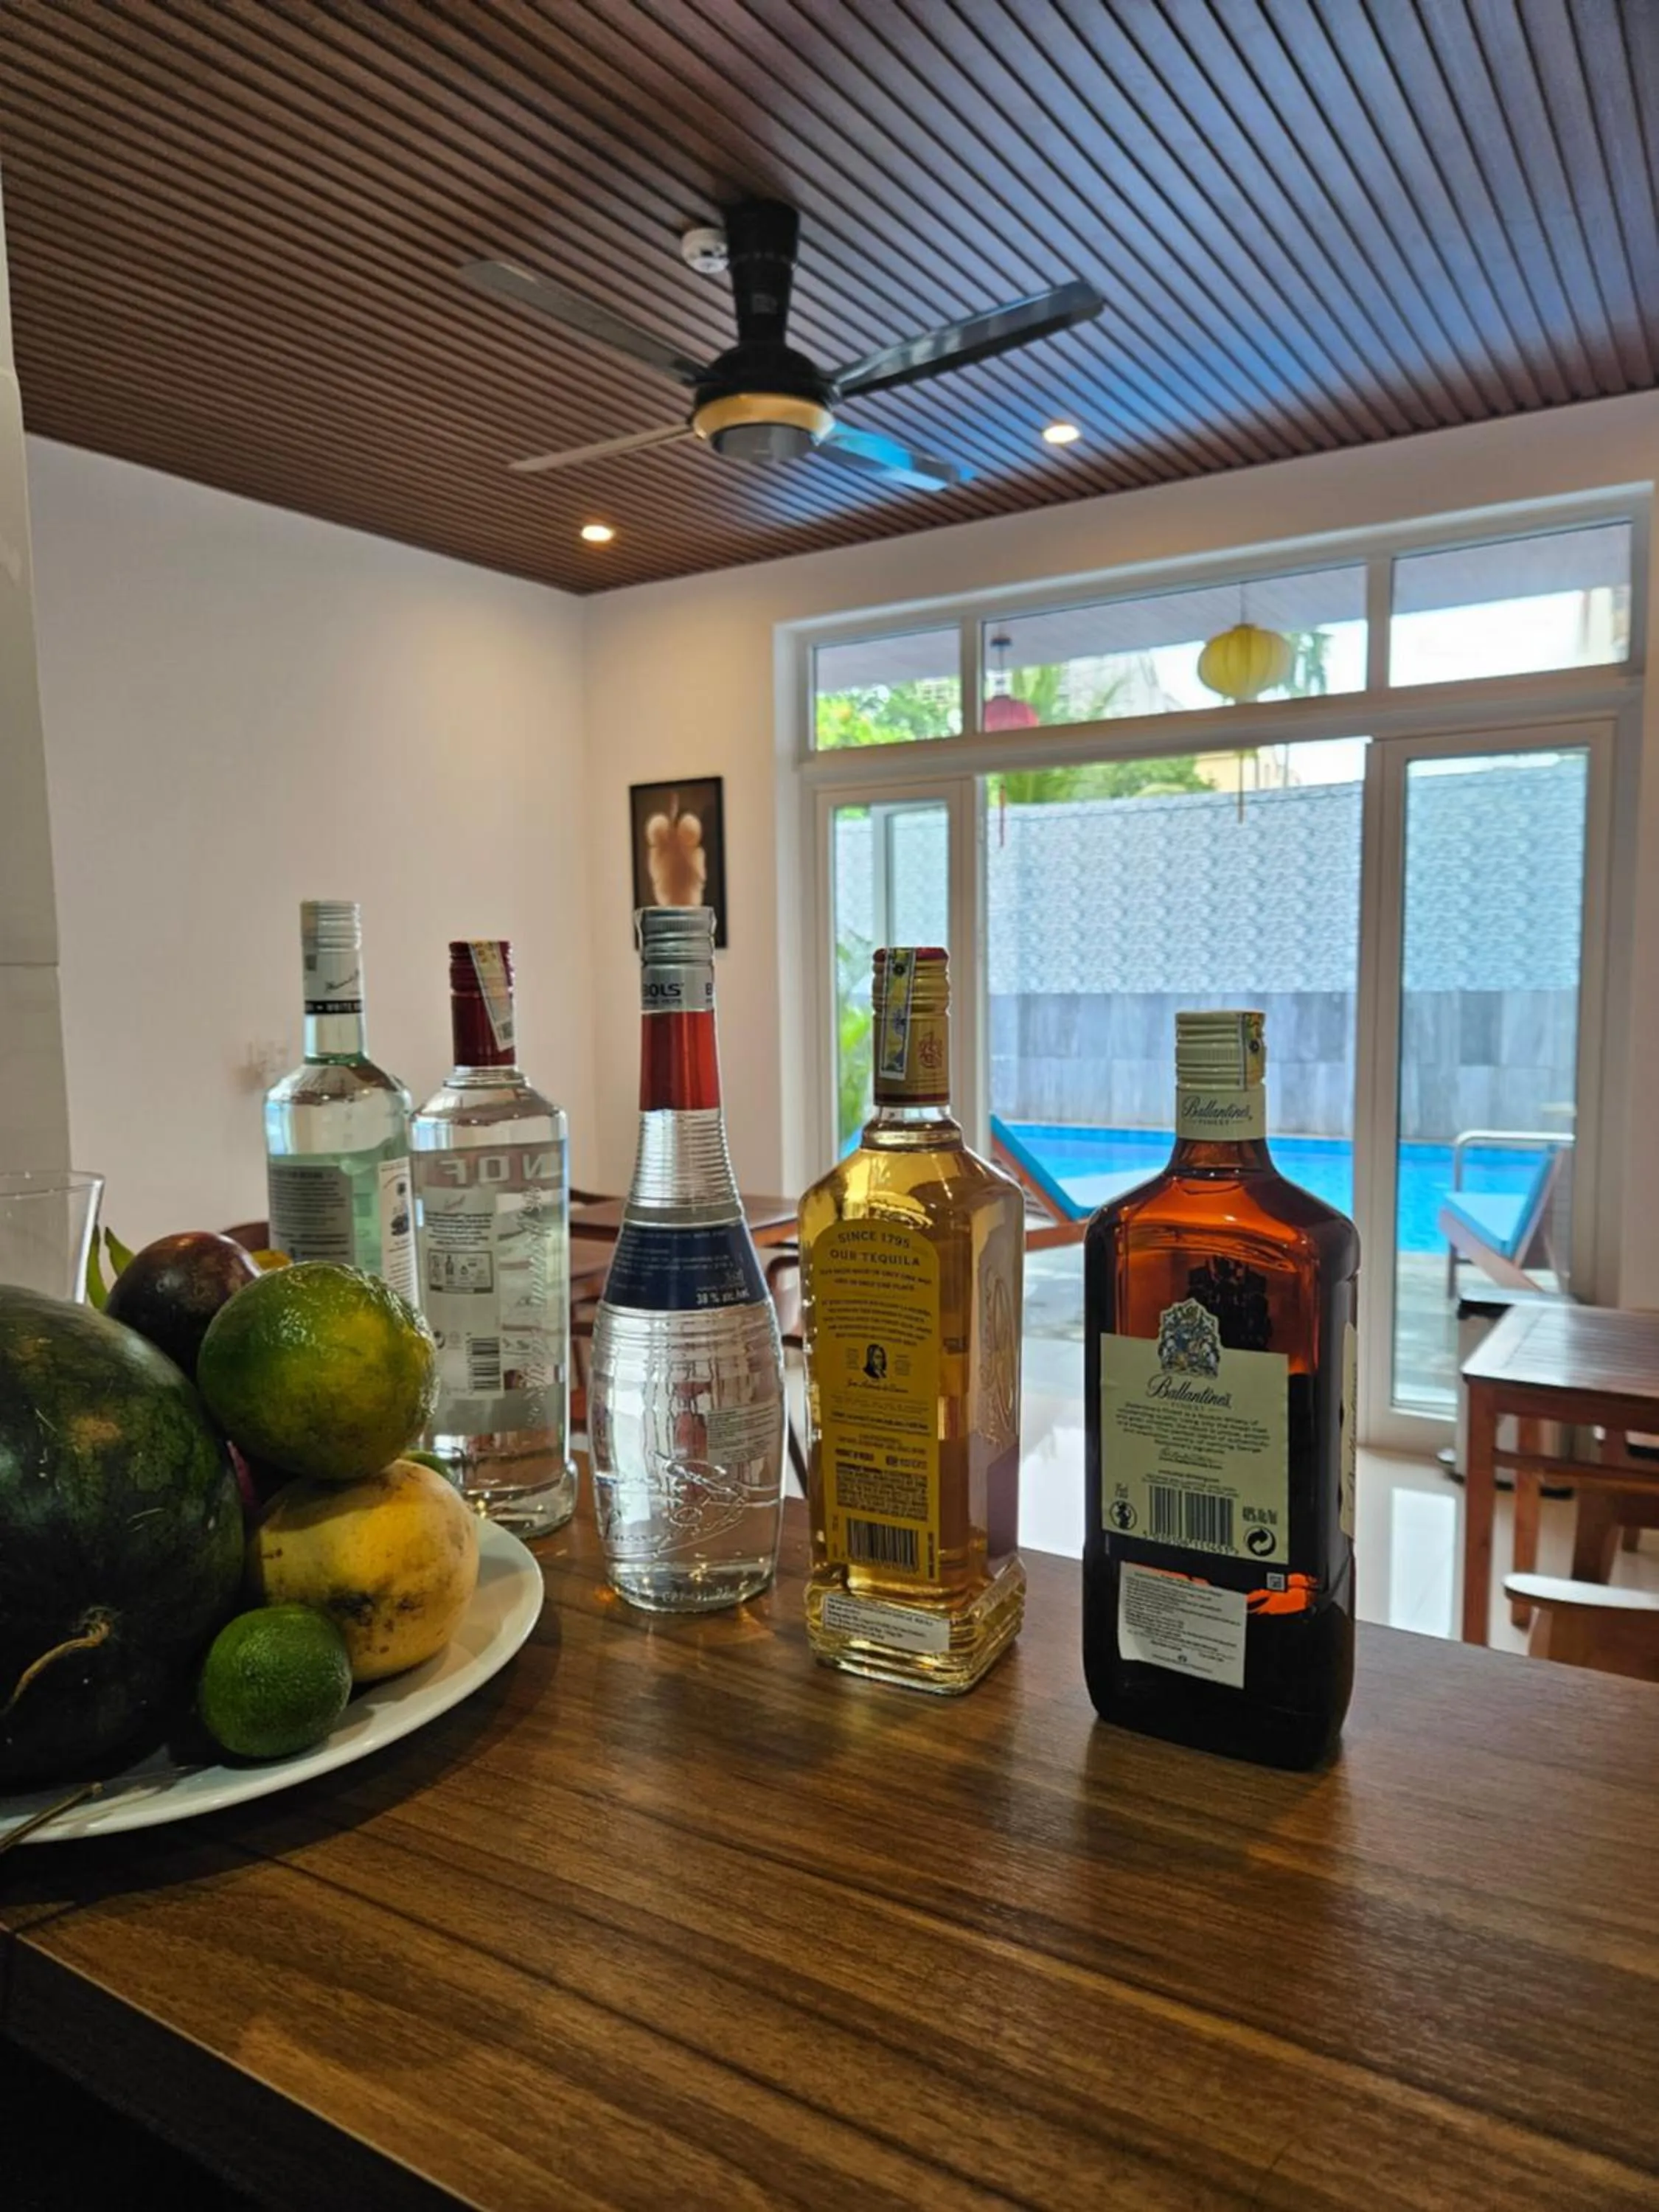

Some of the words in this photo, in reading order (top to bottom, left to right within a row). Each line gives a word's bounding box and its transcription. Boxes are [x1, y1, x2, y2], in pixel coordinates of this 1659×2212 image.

[838, 1231, 877, 1243] SINCE
[882, 1233, 910, 1248] 1795
[830, 1249, 858, 1260] OUR
[860, 1252, 920, 1266] TEQUILA
